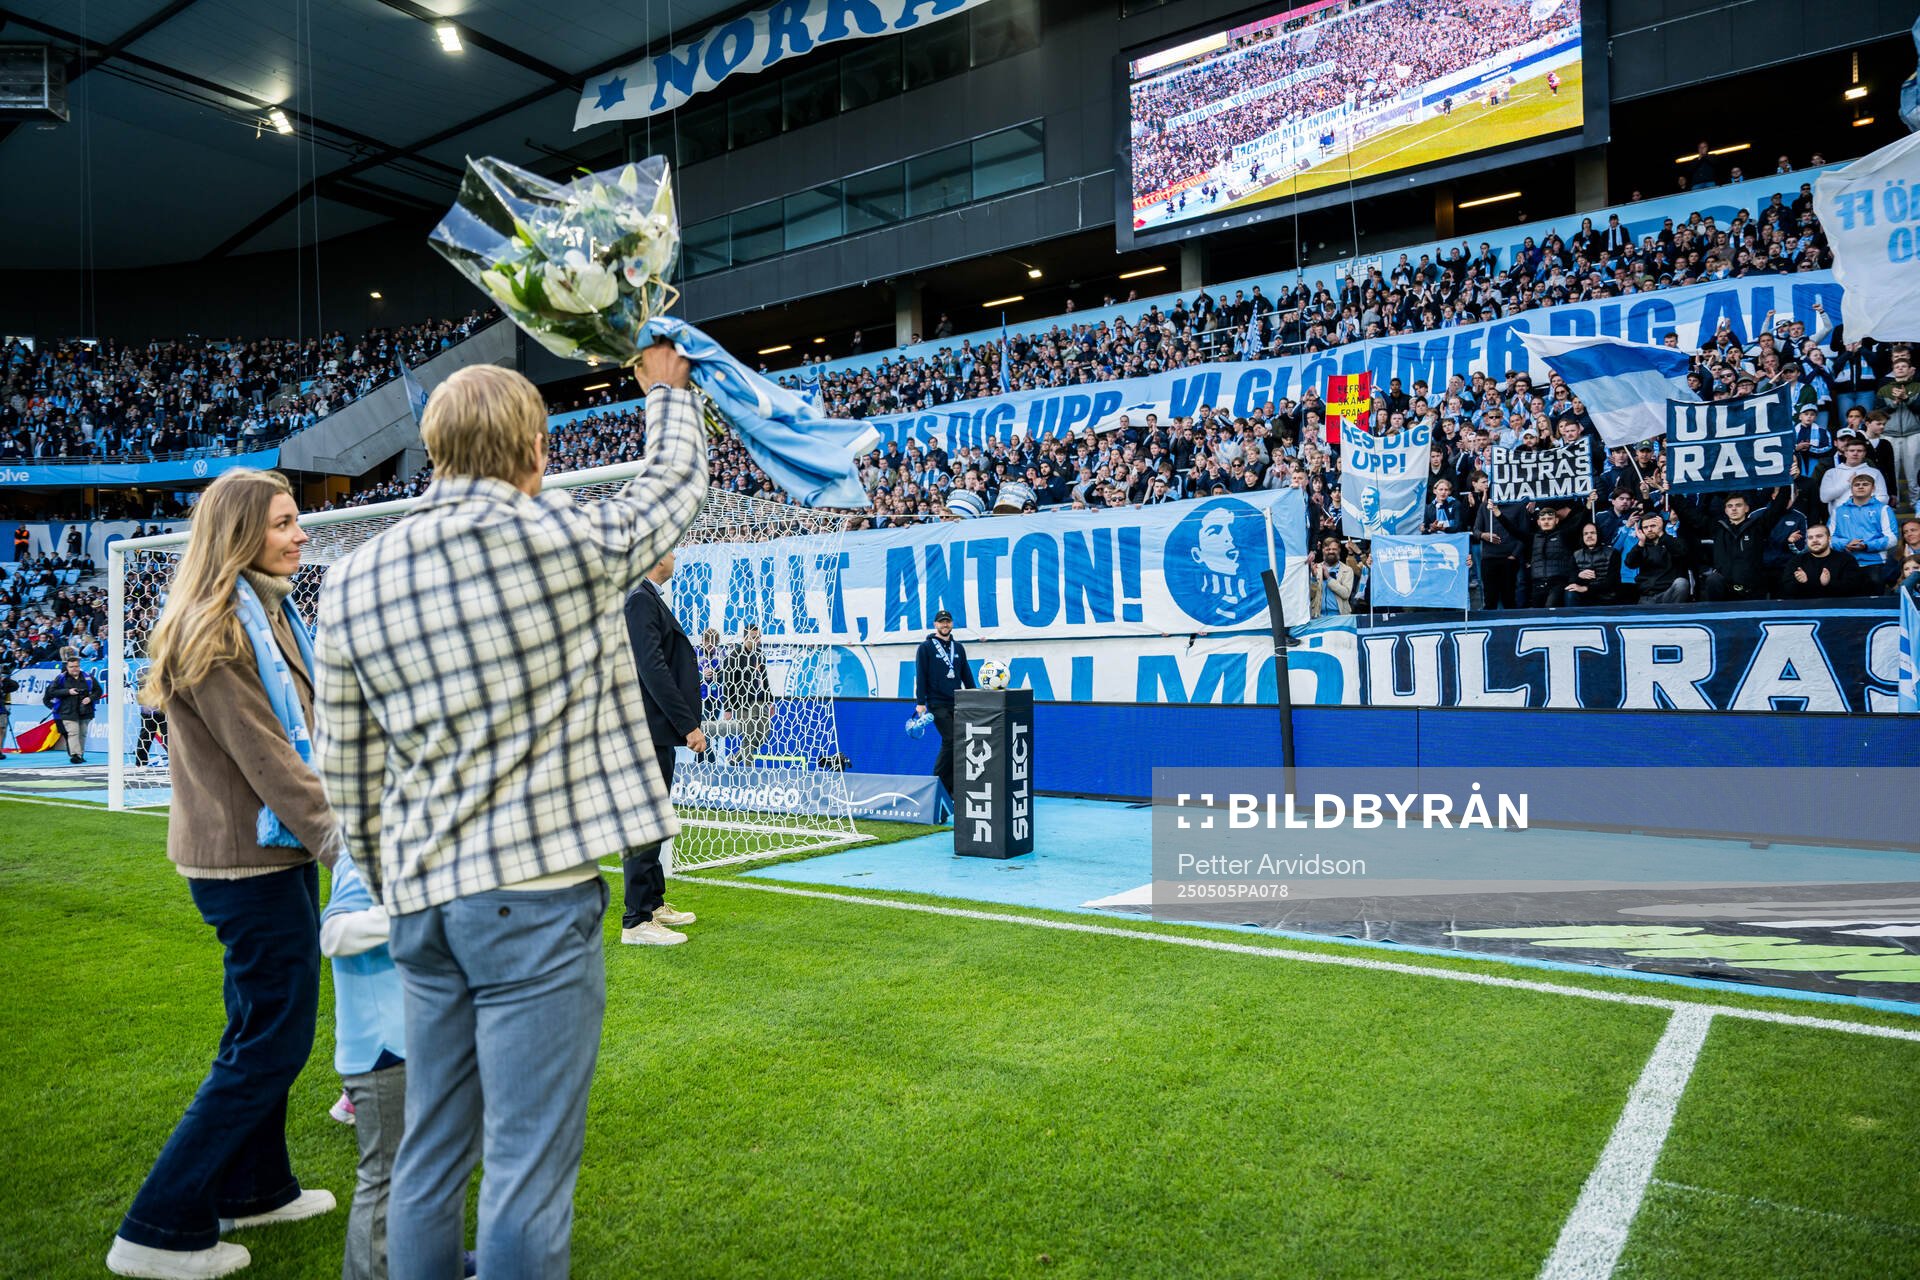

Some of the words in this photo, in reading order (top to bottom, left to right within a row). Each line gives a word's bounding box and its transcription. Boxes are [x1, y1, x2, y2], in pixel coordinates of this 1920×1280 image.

[1028, 391, 1123, 443] UPP
[1168, 372, 1222, 420] VI
[1674, 393, 1780, 441] ULT
[1383, 425, 1430, 451] DIG
[1673, 436, 1784, 484] RAS
[1351, 451, 1406, 474] UPP!
[1493, 456, 1591, 483] ULTRAS
[723, 551, 869, 642] ALLT,
[883, 526, 1143, 632] ANTON!
[965, 722, 992, 843] SELECT
[1012, 722, 1029, 841] SELECT
[847, 806, 919, 818] RESUNDSBRON
